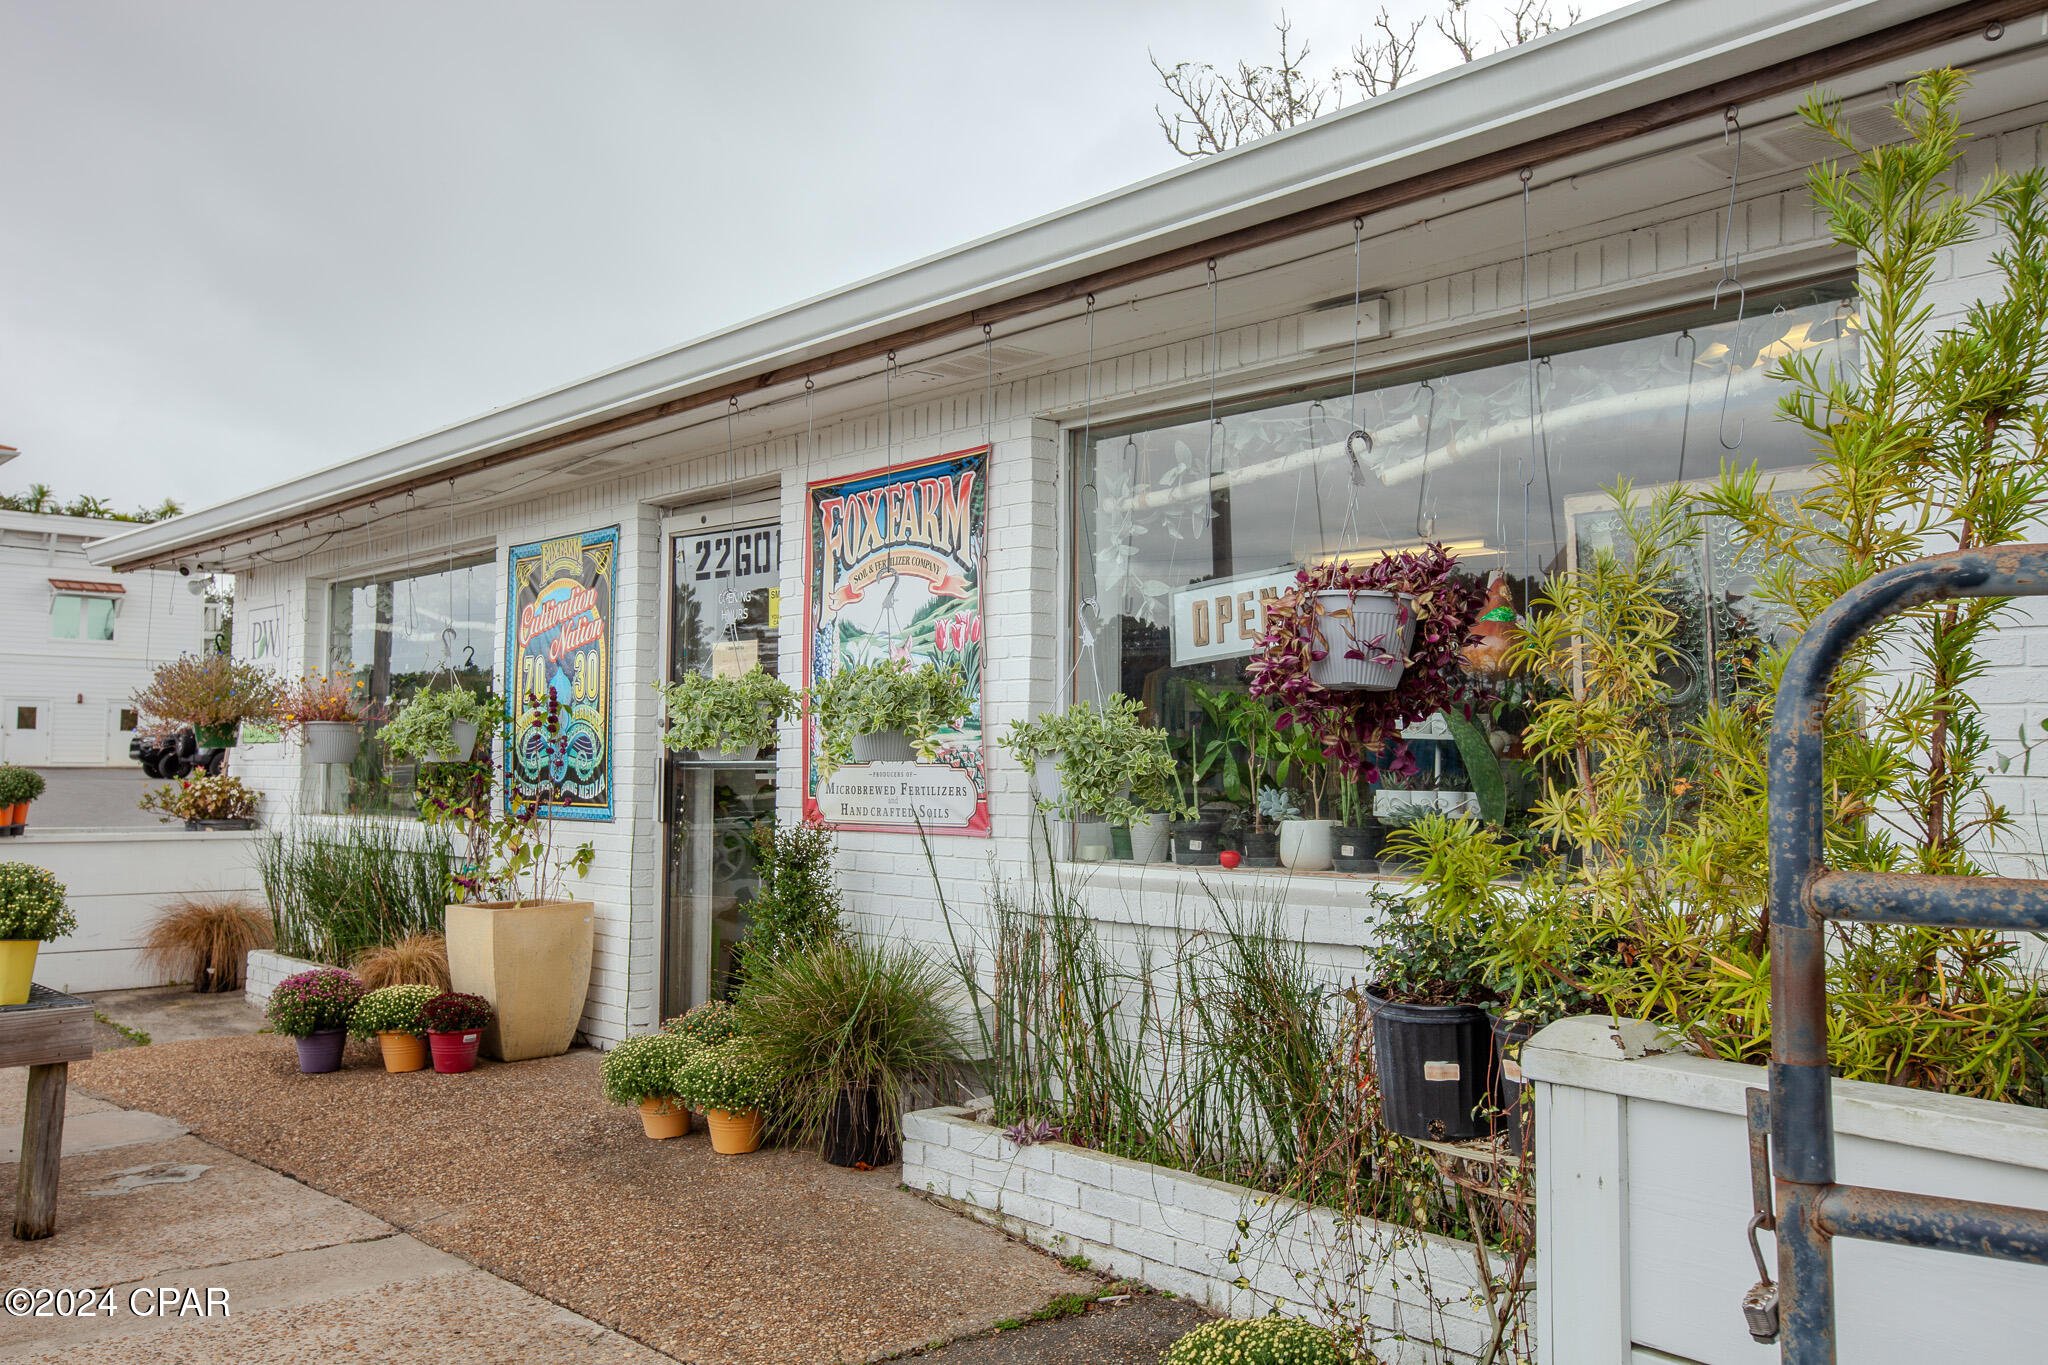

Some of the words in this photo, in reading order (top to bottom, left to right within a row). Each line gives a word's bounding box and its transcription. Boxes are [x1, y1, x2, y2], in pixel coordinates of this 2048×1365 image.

[853, 570, 869, 585] SOIL
[911, 556, 942, 576] COMPANY
[519, 585, 598, 649] Cultivation
[548, 616, 606, 663] Nation
[522, 653, 547, 705] 70
[573, 649, 600, 702] 30
[578, 772, 606, 800] MEDIA
[825, 782, 896, 796] MICROBREWED
[900, 782, 968, 797] FERTILIZERS
[840, 802, 914, 818] HANDCRAFTED
[918, 804, 950, 819] SOILS
